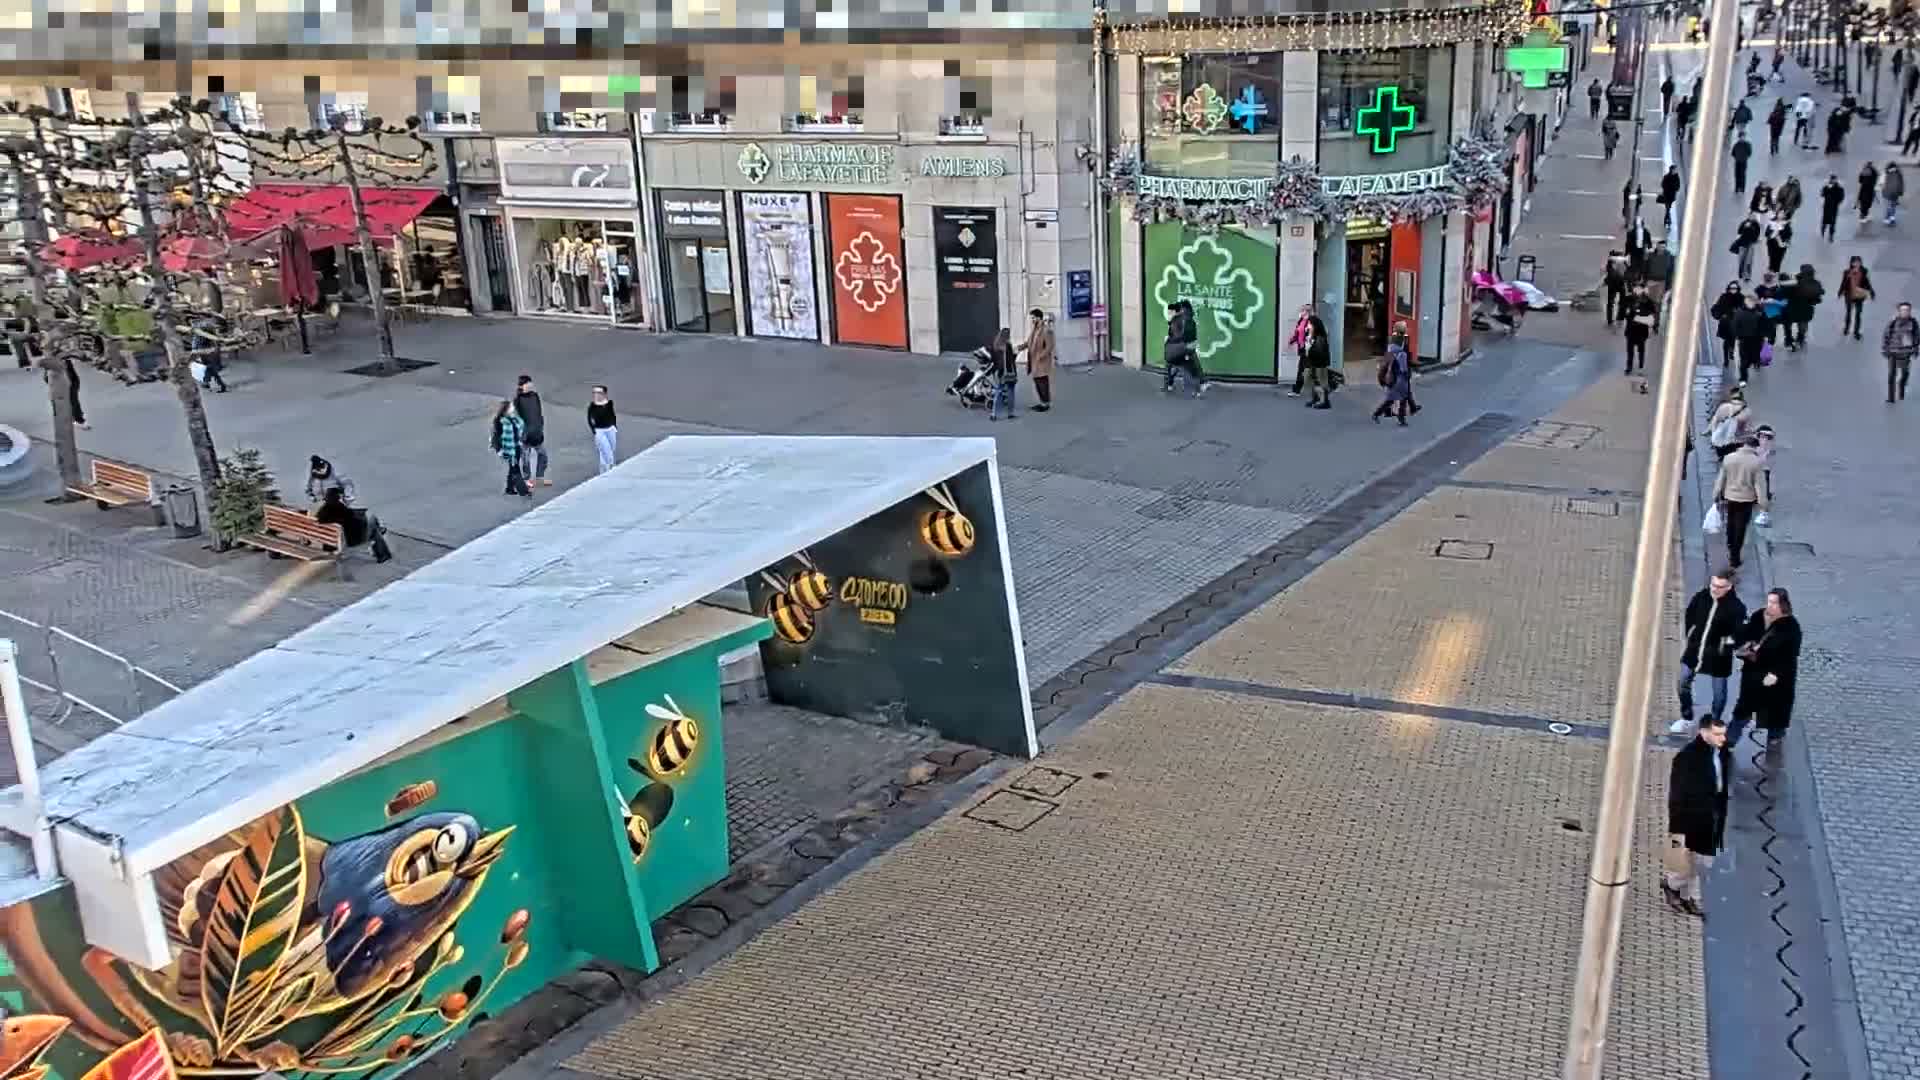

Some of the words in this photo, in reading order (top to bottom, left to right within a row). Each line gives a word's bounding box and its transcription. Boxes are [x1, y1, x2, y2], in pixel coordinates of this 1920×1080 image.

[777, 144, 893, 164] PHARMACIE
[778, 163, 888, 184] LAFAYETTE
[920, 156, 1006, 177] AMIENS
[749, 195, 788, 207] NUXE
